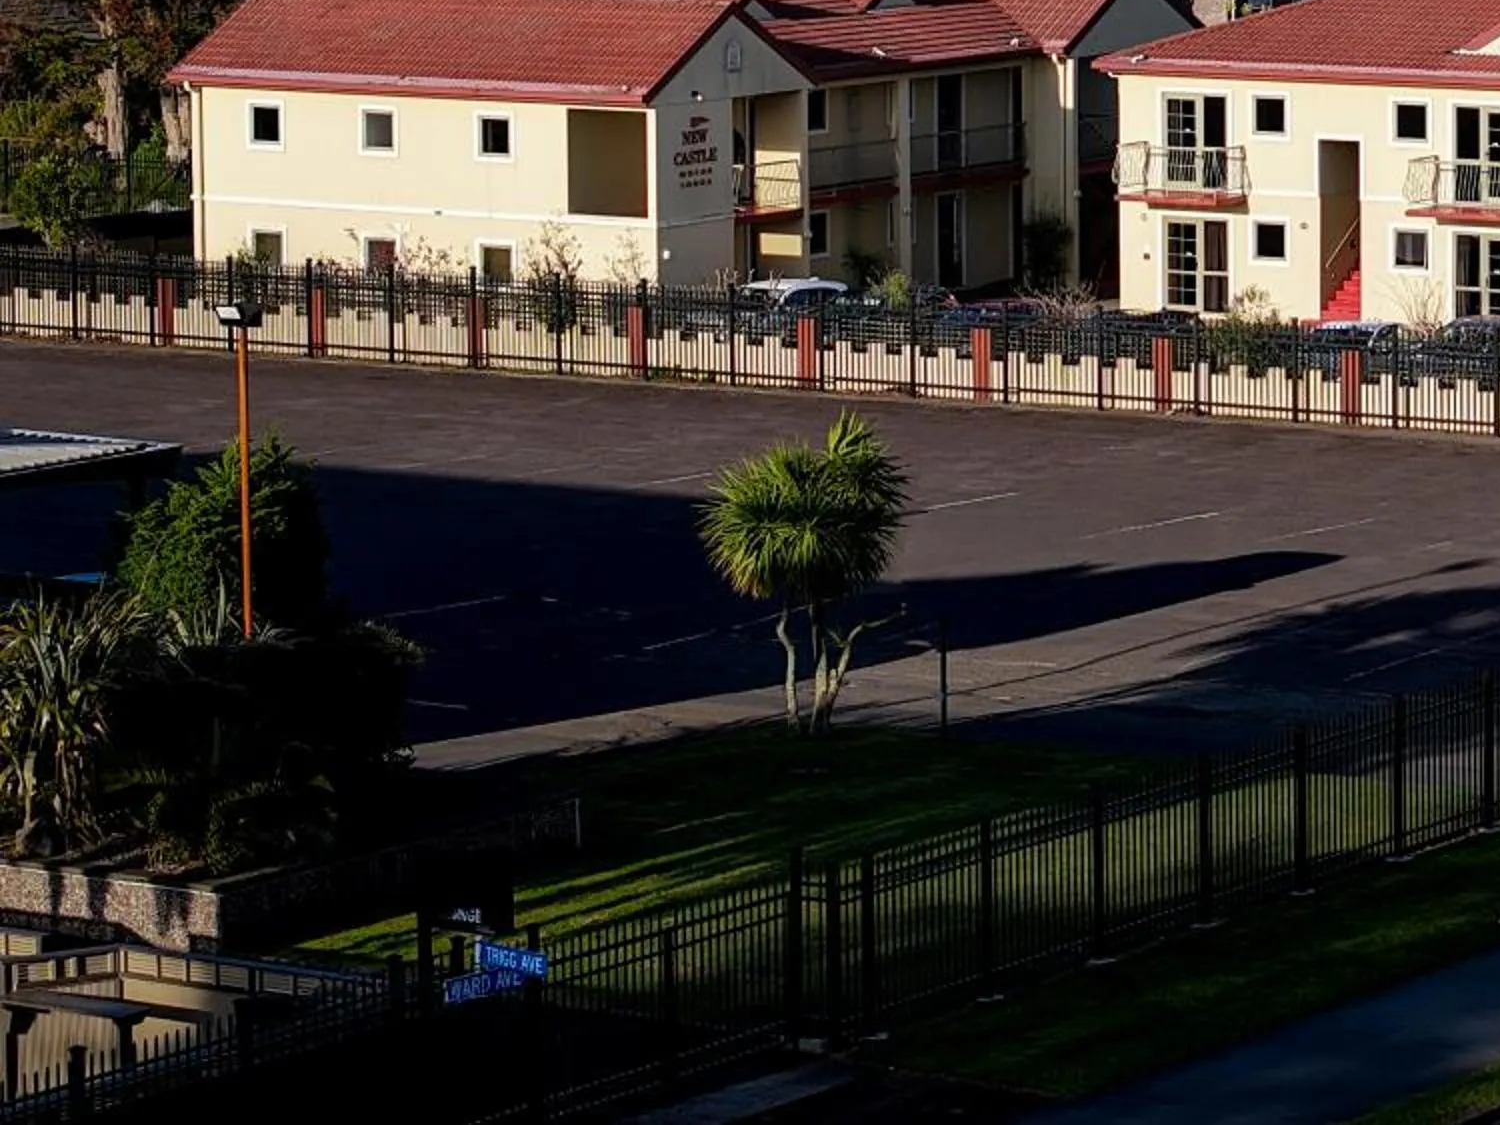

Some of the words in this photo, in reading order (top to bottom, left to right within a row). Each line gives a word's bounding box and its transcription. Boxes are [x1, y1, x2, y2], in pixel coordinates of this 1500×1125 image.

[681, 129, 708, 145] NEW
[673, 147, 718, 166] CASTLE
[486, 946, 517, 968] TRIGG
[521, 954, 544, 974] AVE
[451, 975, 491, 1000] WARD
[495, 971, 522, 990] AVE
